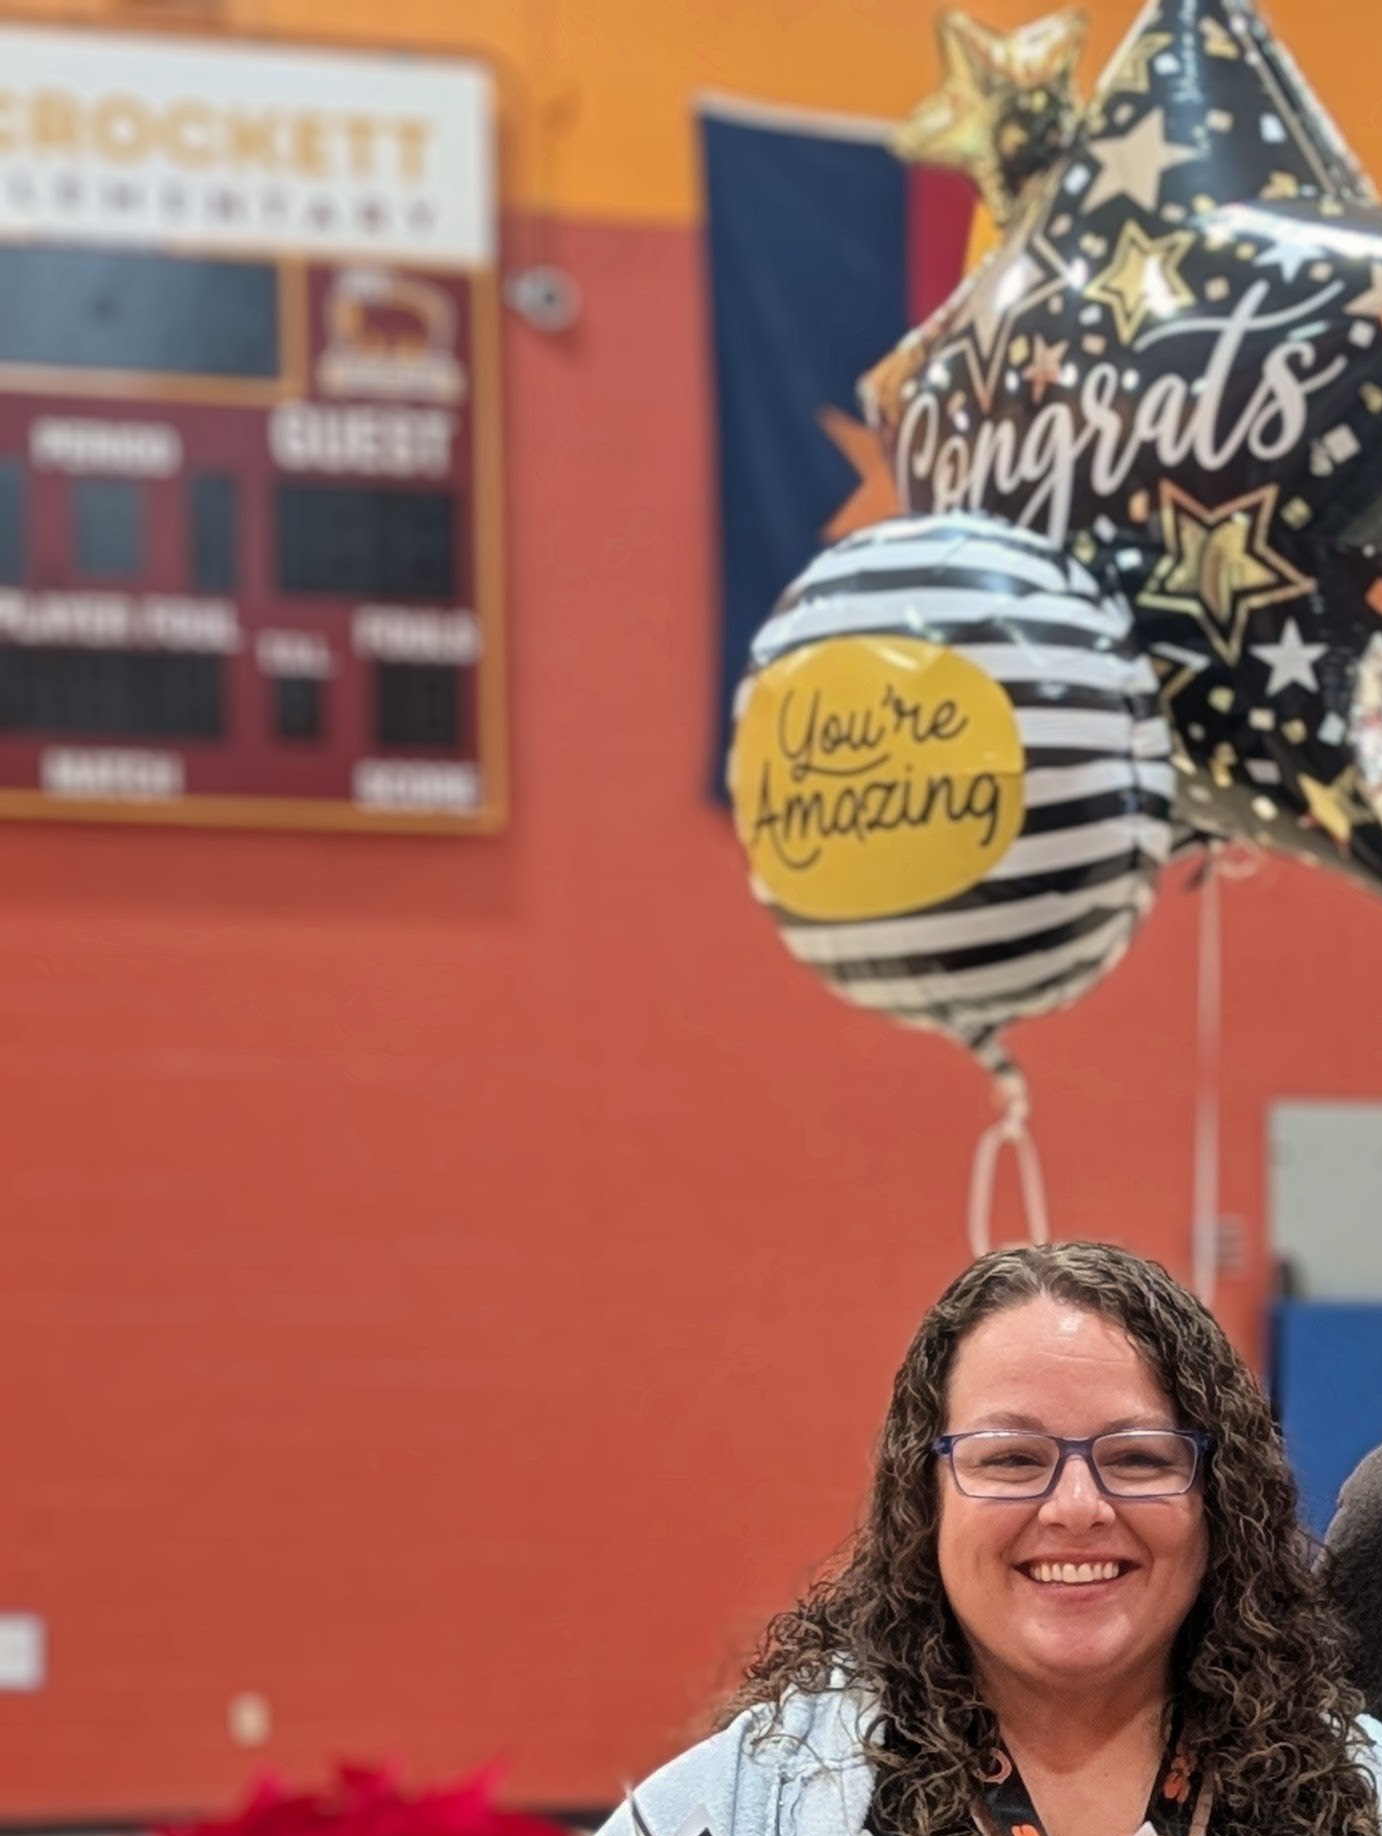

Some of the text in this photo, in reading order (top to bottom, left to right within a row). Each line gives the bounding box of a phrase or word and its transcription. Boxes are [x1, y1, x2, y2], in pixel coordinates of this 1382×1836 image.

[897, 280, 1348, 553] Congrats
[778, 683, 968, 782] You're
[754, 760, 999, 870] Amazing
